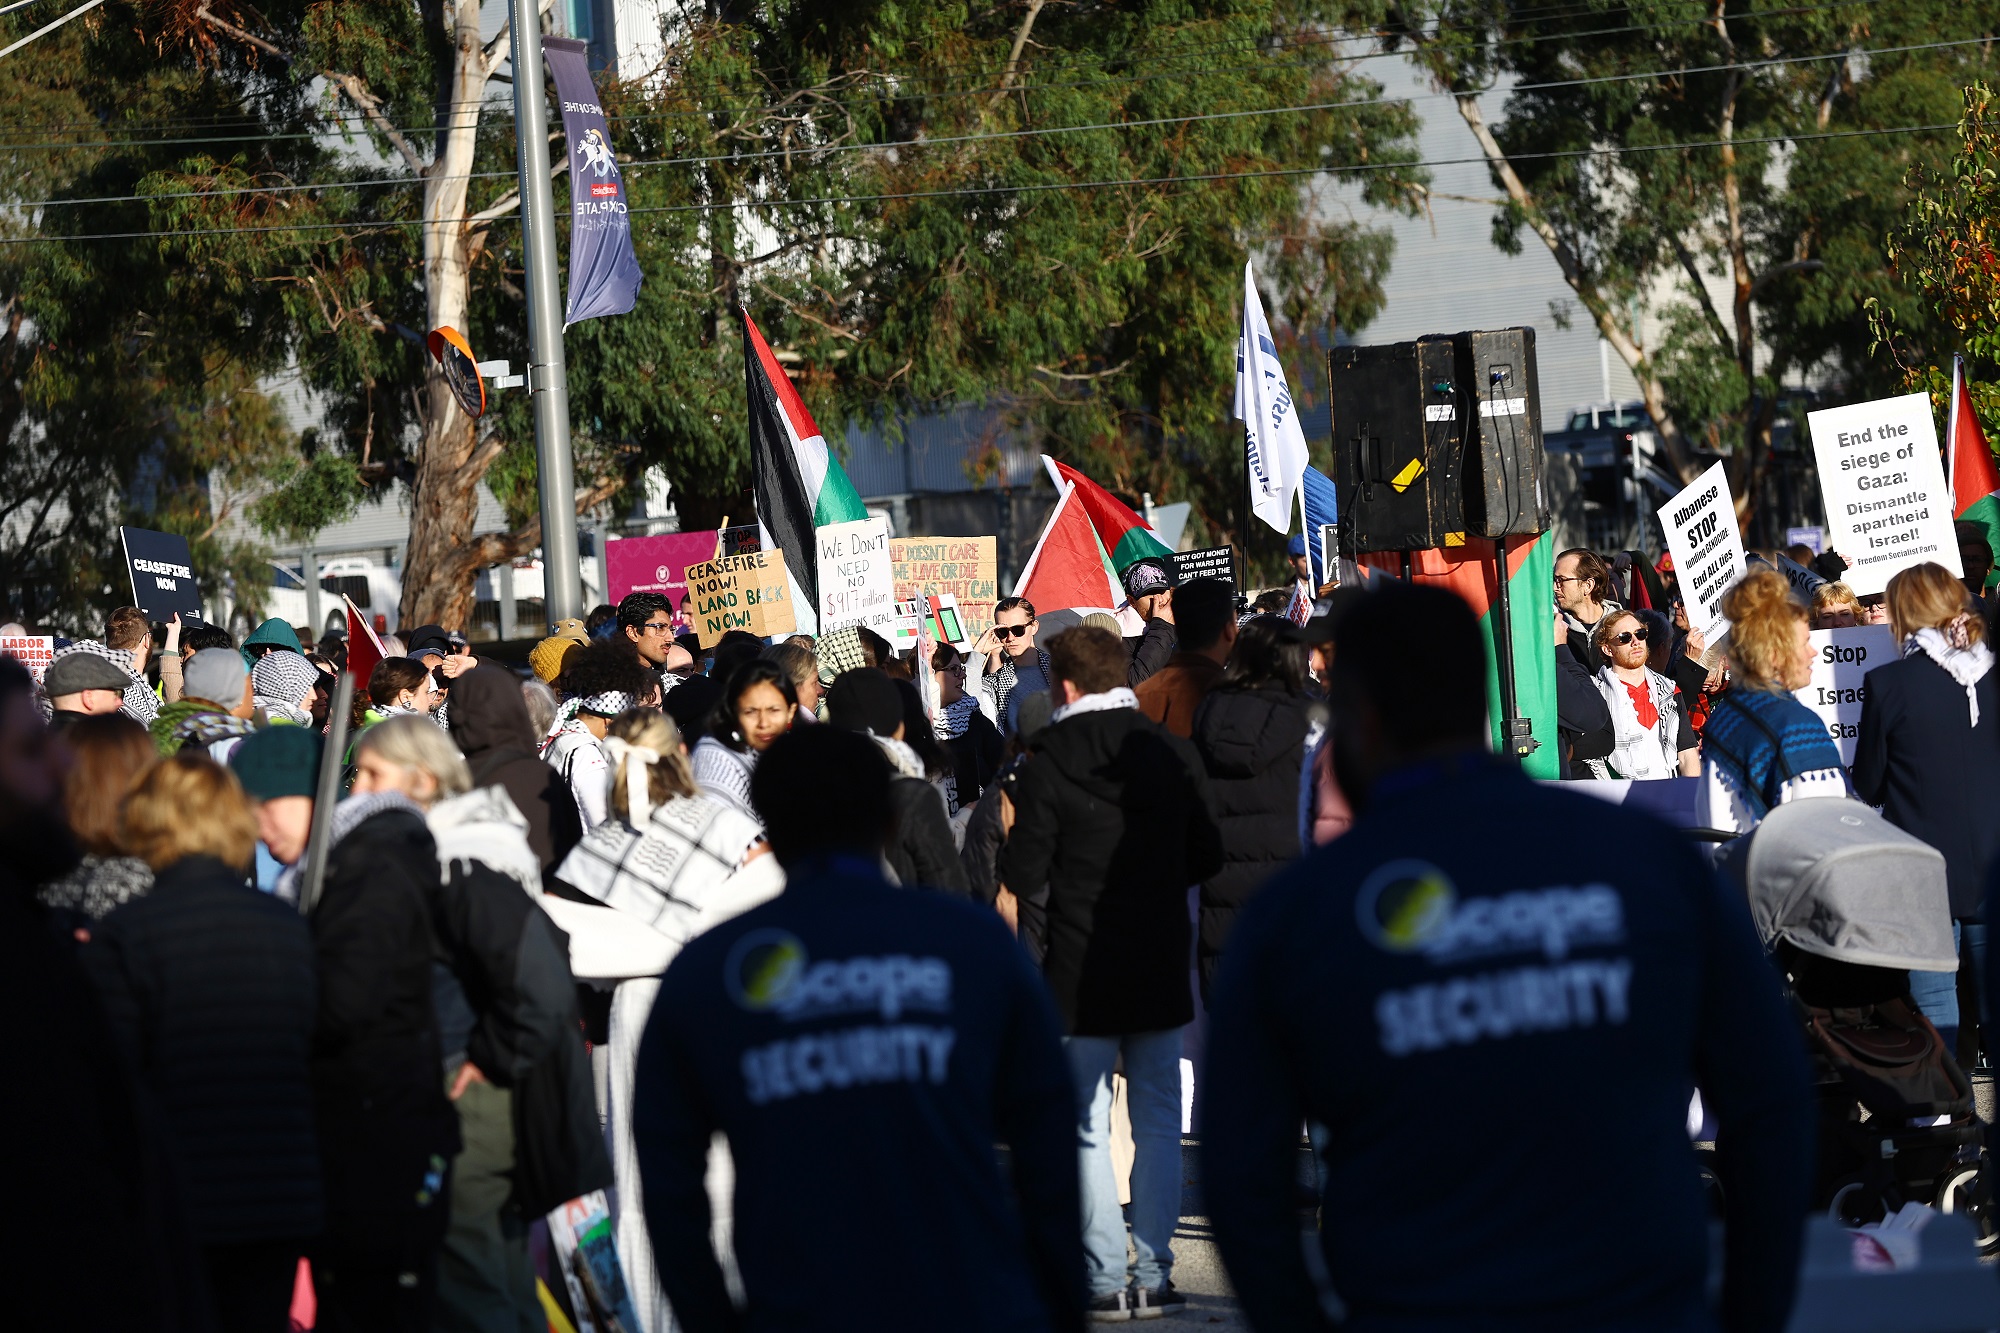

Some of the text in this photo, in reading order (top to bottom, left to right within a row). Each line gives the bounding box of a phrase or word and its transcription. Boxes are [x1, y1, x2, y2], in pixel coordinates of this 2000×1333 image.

[1837, 423, 1909, 448] End the
[1840, 442, 1914, 471] siege of
[1857, 471, 1909, 491] Gaza:
[1673, 485, 1719, 529] Albanese
[1846, 491, 1928, 516] Dismantle
[1687, 511, 1718, 550] STOP
[1852, 507, 1930, 534] apartheid
[1868, 527, 1920, 549] Israel!
[948, 543, 980, 561] CARE
[1173, 548, 1230, 563] THEY GOT MONEY
[1685, 548, 1707, 570] funding
[1857, 543, 1938, 566] Freedom Socialist Party
[133, 558, 192, 580] CEASEFIRE
[688, 553, 769, 581] CEASEFIRE
[837, 559, 870, 578] NEED
[892, 563, 979, 580] WE LIVE OR DIE
[1178, 567, 1231, 580] CAN'T FEED THE
[1180, 557, 1230, 570] FOR WARS BUT
[1692, 549, 1733, 590] End ALL ties
[155, 576, 177, 592] NOW
[696, 575, 738, 597] NOW!
[848, 575, 866, 588] NO
[924, 582, 938, 597] AS
[938, 580, 971, 598] THEY
[971, 580, 994, 598] CAN
[1698, 564, 1736, 605] with Israel
[697, 592, 738, 616] LAND
[745, 585, 784, 606] BACK
[826, 588, 889, 616] $917 million
[1709, 594, 1723, 619] NO
[707, 609, 752, 634] NOW!
[824, 612, 893, 633] WEAPONS DEAL
[2, 638, 45, 649] LABOR
[1822, 644, 1868, 667] Stop
[1816, 687, 1866, 706] Israe
[1829, 722, 1861, 740] Sta
[1375, 956, 1635, 1057] SECURITY
[741, 1023, 957, 1106] SECURITY
